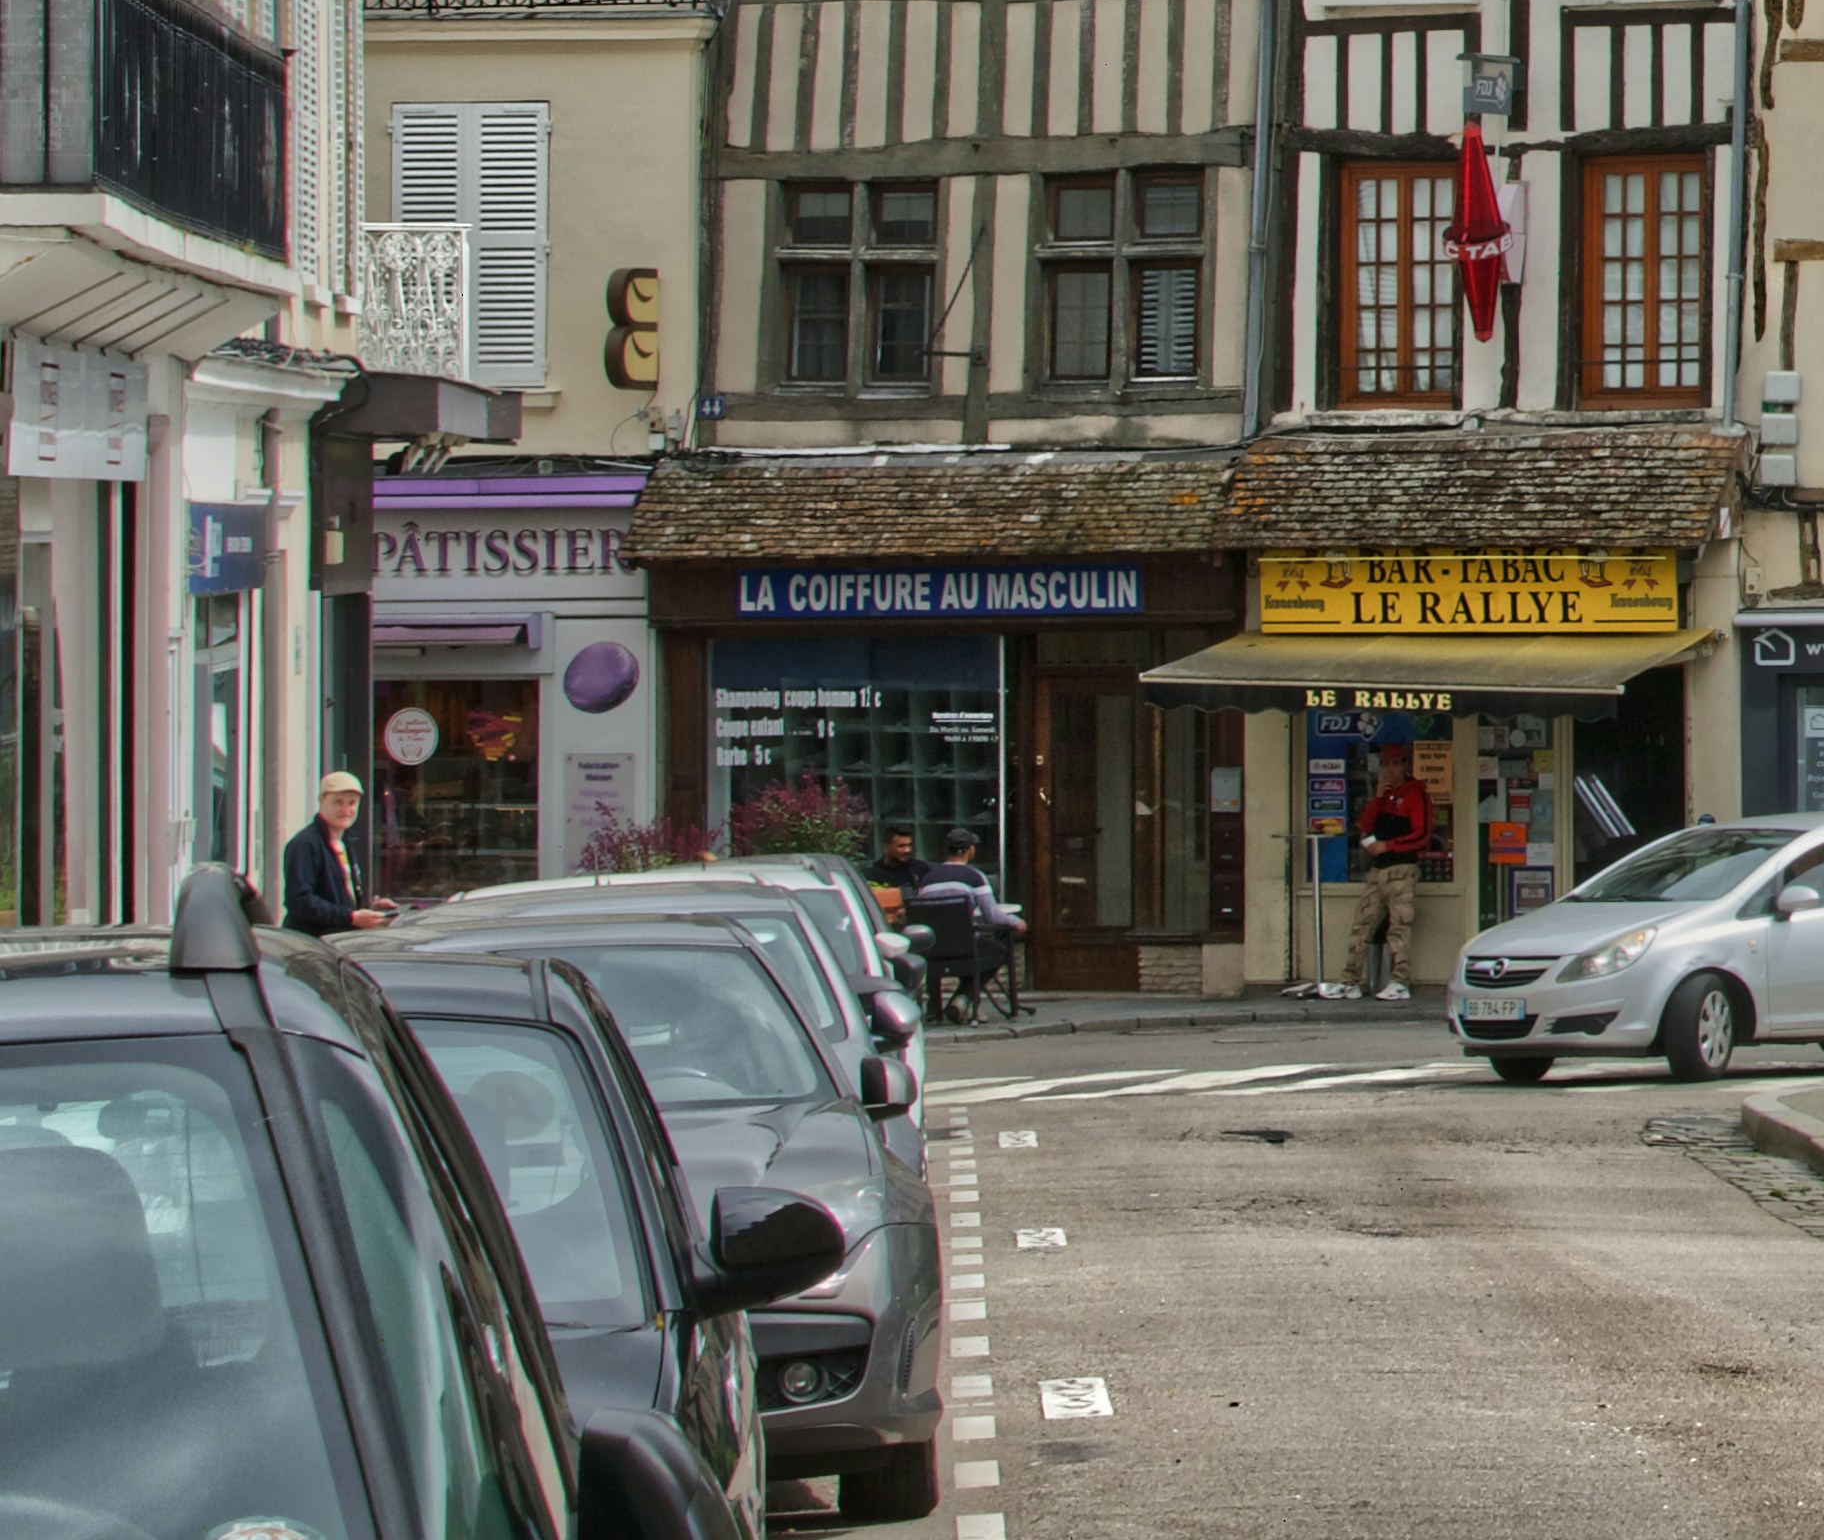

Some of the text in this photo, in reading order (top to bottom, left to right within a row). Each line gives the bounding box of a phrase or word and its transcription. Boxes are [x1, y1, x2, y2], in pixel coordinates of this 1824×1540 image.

[1476, 79, 1493, 97] FDJ
[1367, 550, 1435, 584] BAR
[1459, 550, 1566, 584] TABAC
[740, 570, 1137, 612] LA COIFFURE AU MASCULIN
[1351, 590, 1584, 625] LE RALLYE
[1306, 689, 1453, 711] LE RALLYE
[1320, 715, 1352, 731] FDJ
